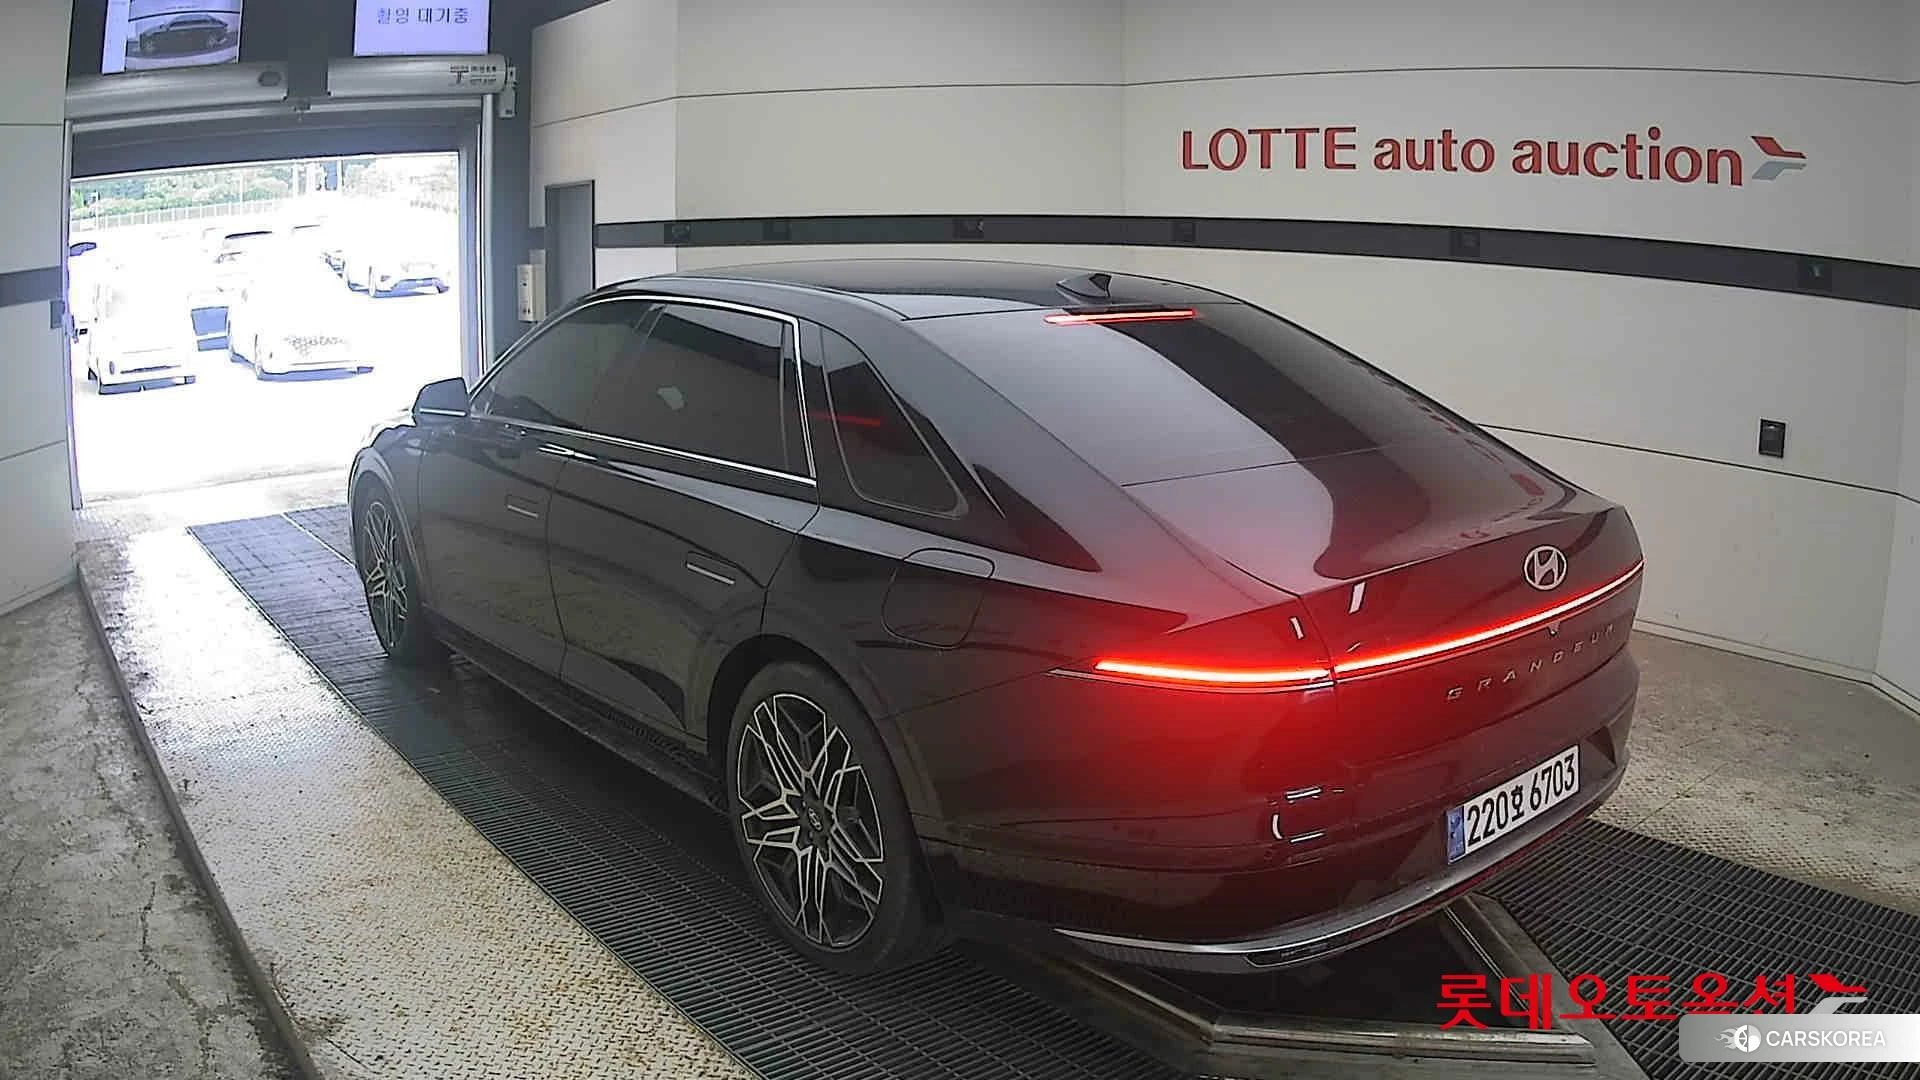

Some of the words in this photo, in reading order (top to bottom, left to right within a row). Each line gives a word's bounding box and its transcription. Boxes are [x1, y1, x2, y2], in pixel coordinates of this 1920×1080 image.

[418, 7, 470, 24] 대기중
[1182, 126, 1357, 171] LOTTE
[1374, 128, 1496, 173] auto
[1512, 126, 1744, 187] auction
[1447, 623, 1615, 701] GRANDEUR
[1467, 785, 1524, 847] 220호
[1530, 753, 1575, 811] 6703
